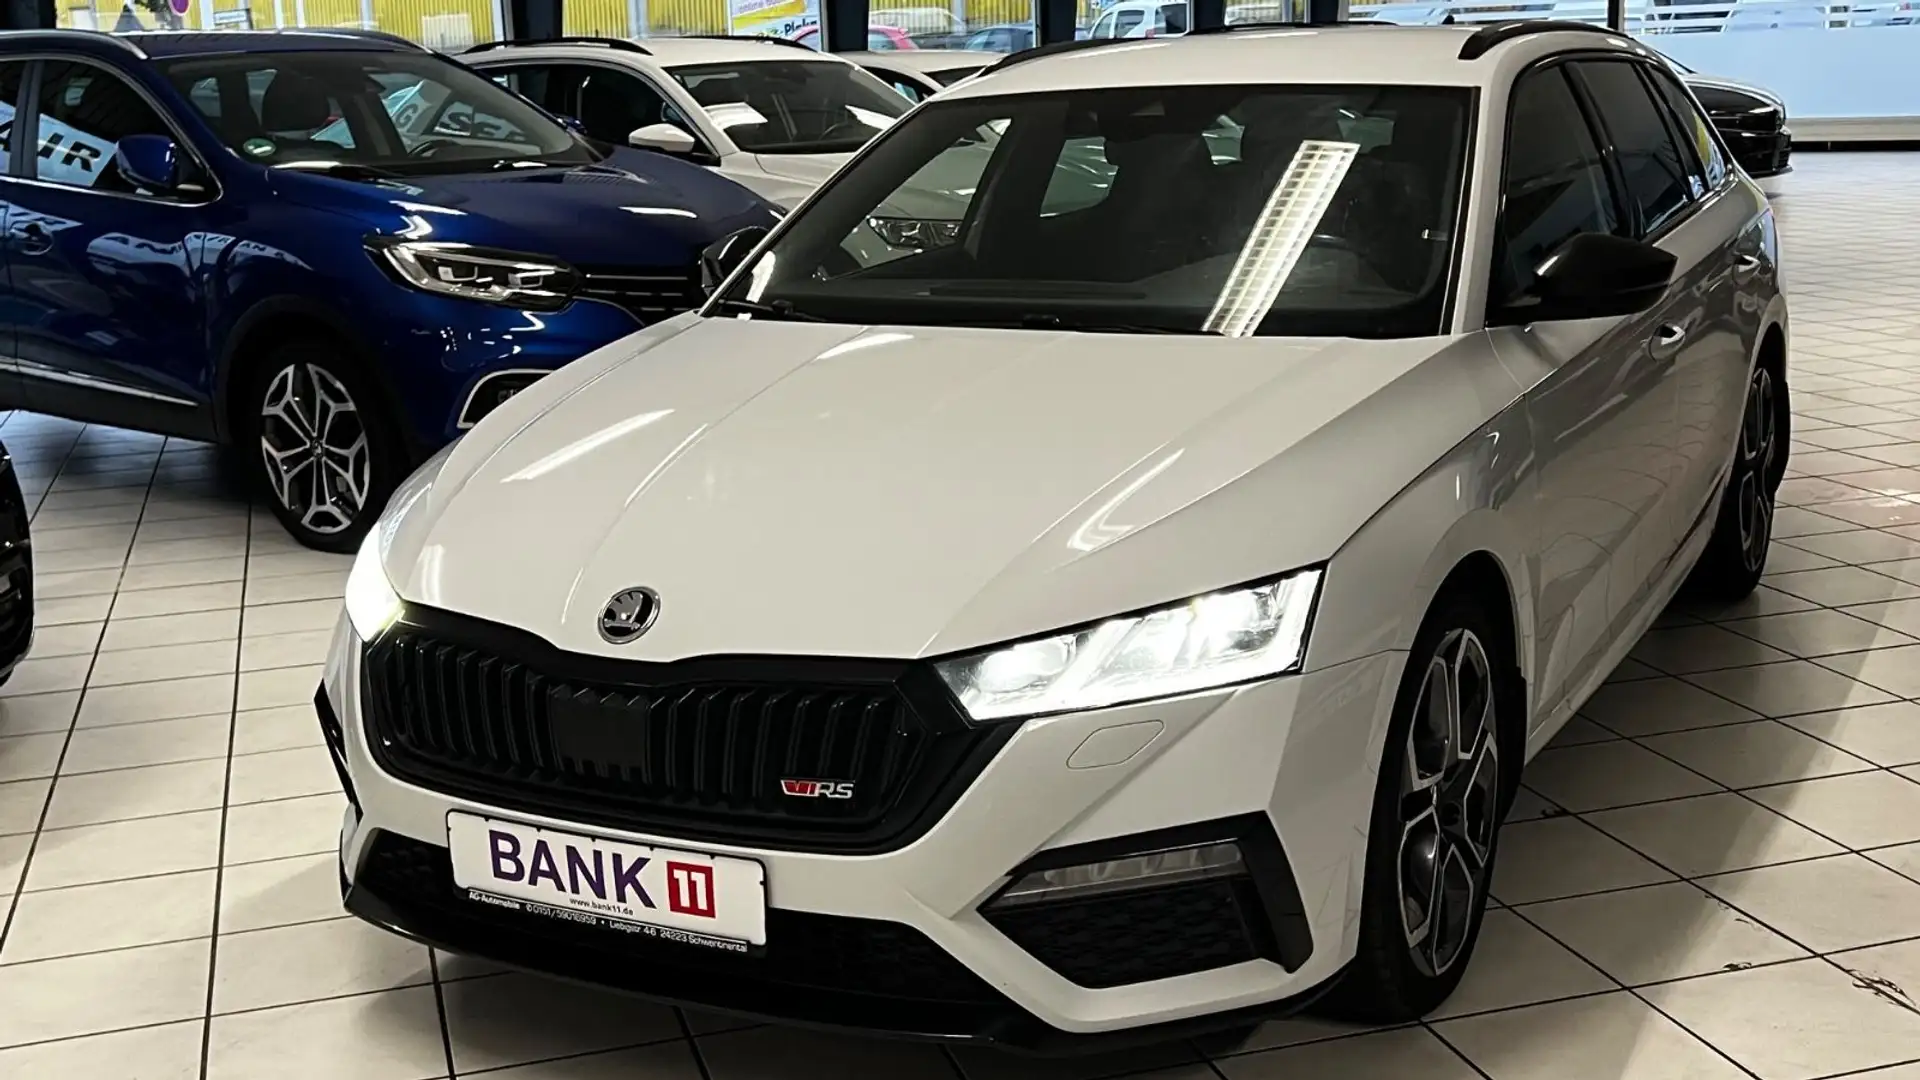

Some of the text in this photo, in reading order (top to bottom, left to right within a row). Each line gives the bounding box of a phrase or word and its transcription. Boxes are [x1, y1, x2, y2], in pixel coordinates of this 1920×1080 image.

[488, 829, 708, 911] BANK 11
[569, 898, 634, 916] www.bank11.de
